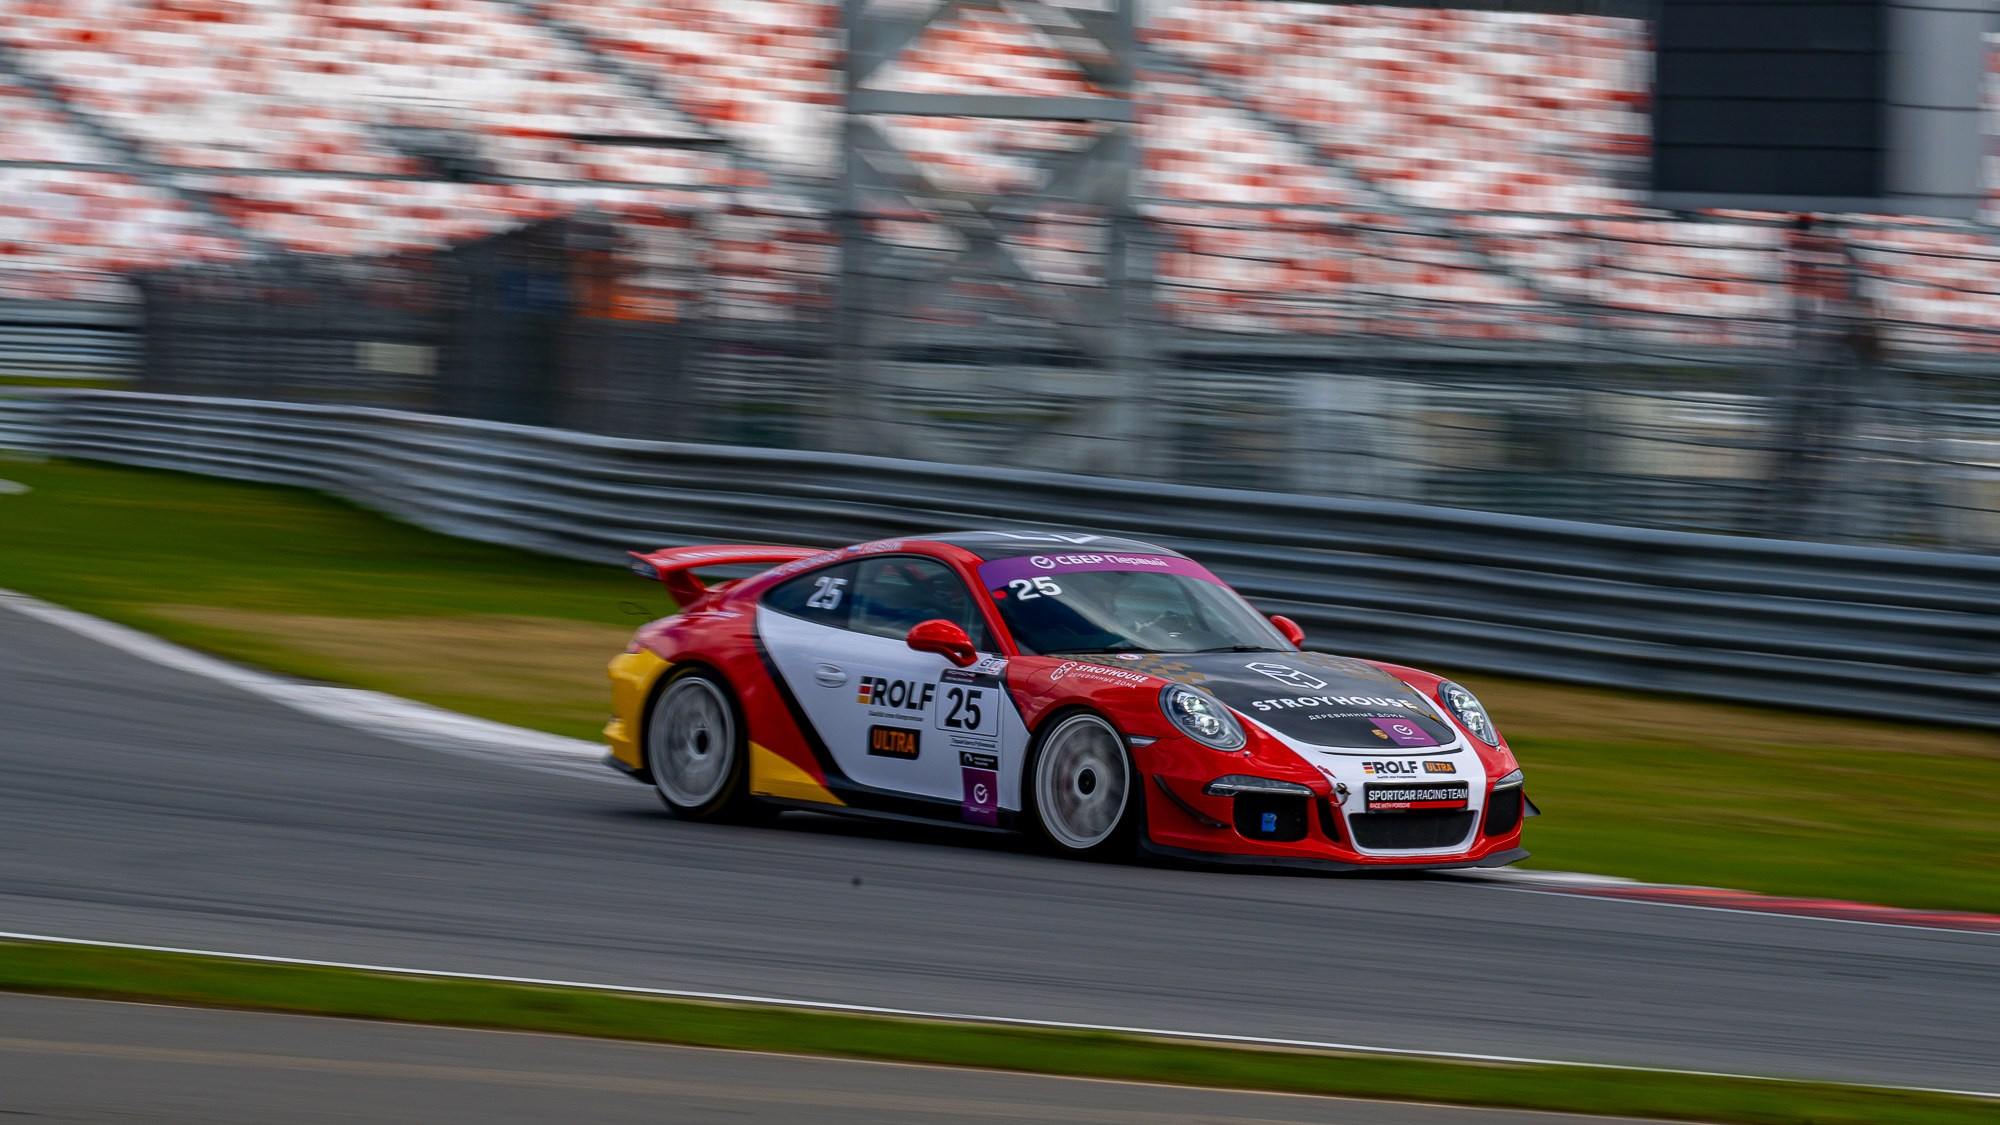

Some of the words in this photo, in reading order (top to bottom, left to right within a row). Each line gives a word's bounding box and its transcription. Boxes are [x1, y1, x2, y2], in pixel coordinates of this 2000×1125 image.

[1055, 555, 1104, 565] СБЕР
[1104, 555, 1170, 567] Первый
[806, 576, 848, 611] 25
[1008, 576, 1062, 601] 25
[1067, 672, 1115, 683] ДЕРЕВЯННЫЕ
[1113, 680, 1137, 689] ДОМА
[1075, 664, 1149, 683] STROYHOUSE
[870, 677, 936, 711] ROLF
[944, 687, 983, 731] 25
[1251, 695, 1418, 712] STROYHOUSE
[1308, 712, 1375, 720] ДЕРЕВЯННЫЕ
[872, 729, 916, 754] ULTRA
[1372, 761, 1418, 774] ROLF
[1425, 762, 1454, 772] ULTRA
[1368, 789, 1416, 801] SPORTCAR
[1416, 789, 1447, 800] RACING
[1447, 788, 1468, 799] TEAM
